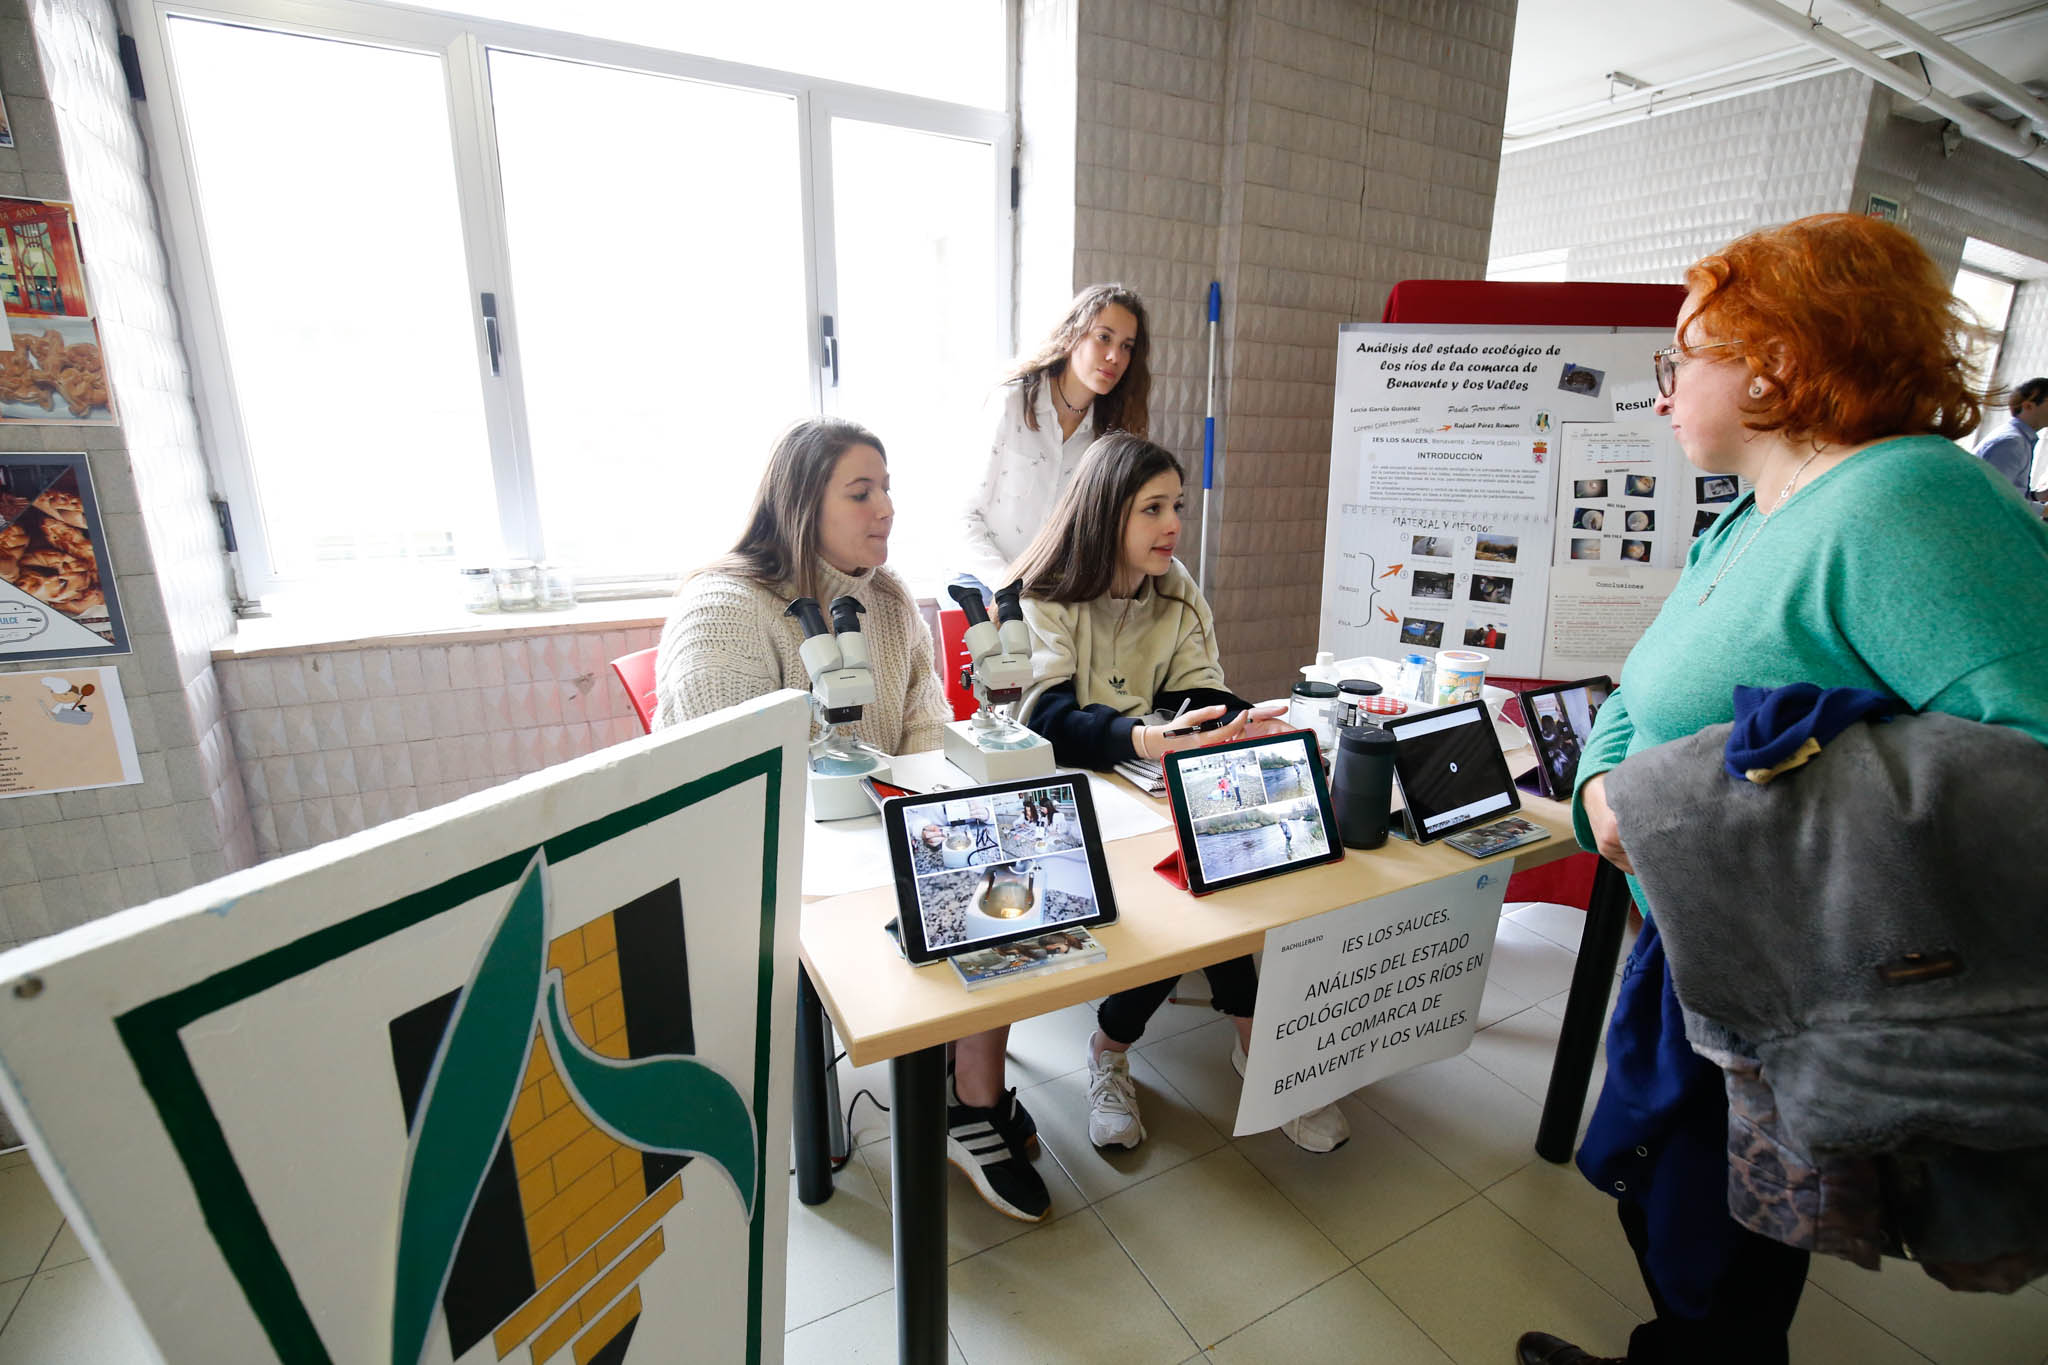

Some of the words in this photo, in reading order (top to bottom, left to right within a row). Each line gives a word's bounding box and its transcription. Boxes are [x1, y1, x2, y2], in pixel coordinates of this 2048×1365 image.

[1356, 342, 1409, 354] Análisis
[1412, 342, 1434, 354] del
[1436, 343, 1479, 355] estado
[1482, 343, 1542, 358] ecológico
[1545, 344, 1561, 356] de
[1380, 360, 1401, 371] los
[1404, 360, 1428, 372] ríos
[1430, 361, 1446, 372] de
[1449, 360, 1464, 372] la
[1467, 363, 1519, 373] comarca
[1522, 361, 1538, 373] de
[1386, 377, 1448, 390] Benavente
[1451, 381, 1459, 391] y
[1462, 379, 1484, 391] los
[1486, 379, 1529, 391] Valles
[1417, 451, 1483, 461] INTRODUCCIÓN
[1393, 516, 1440, 530] MATERIAL
[1442, 521, 1449, 530] Y
[1342, 934, 1364, 954] IES
[1367, 928, 1393, 945] LOS
[1395, 908, 1451, 936] SAUCES.
[1281, 935, 1324, 953] BACHILLERATO
[1305, 963, 1377, 1001] ANÁLISIS
[1380, 954, 1407, 975] DEL
[1411, 933, 1470, 963] ESTADO
[1276, 993, 1370, 1040] ECOLÓGICO
[1373, 983, 1394, 1003] DE
[1397, 973, 1426, 995] LOS
[1429, 962, 1463, 984] RÍOS
[1466, 953, 1484, 972] EN
[1317, 1034, 1336, 1051] LA
[1340, 1001, 1418, 1042] COMARCA
[1421, 993, 1443, 1011] DE
[1274, 1047, 1366, 1095] BENAVENTE
[1370, 1038, 1379, 1054] Y
[1382, 1029, 1411, 1049] LOS
[1415, 1010, 1468, 1039] VALLES.
